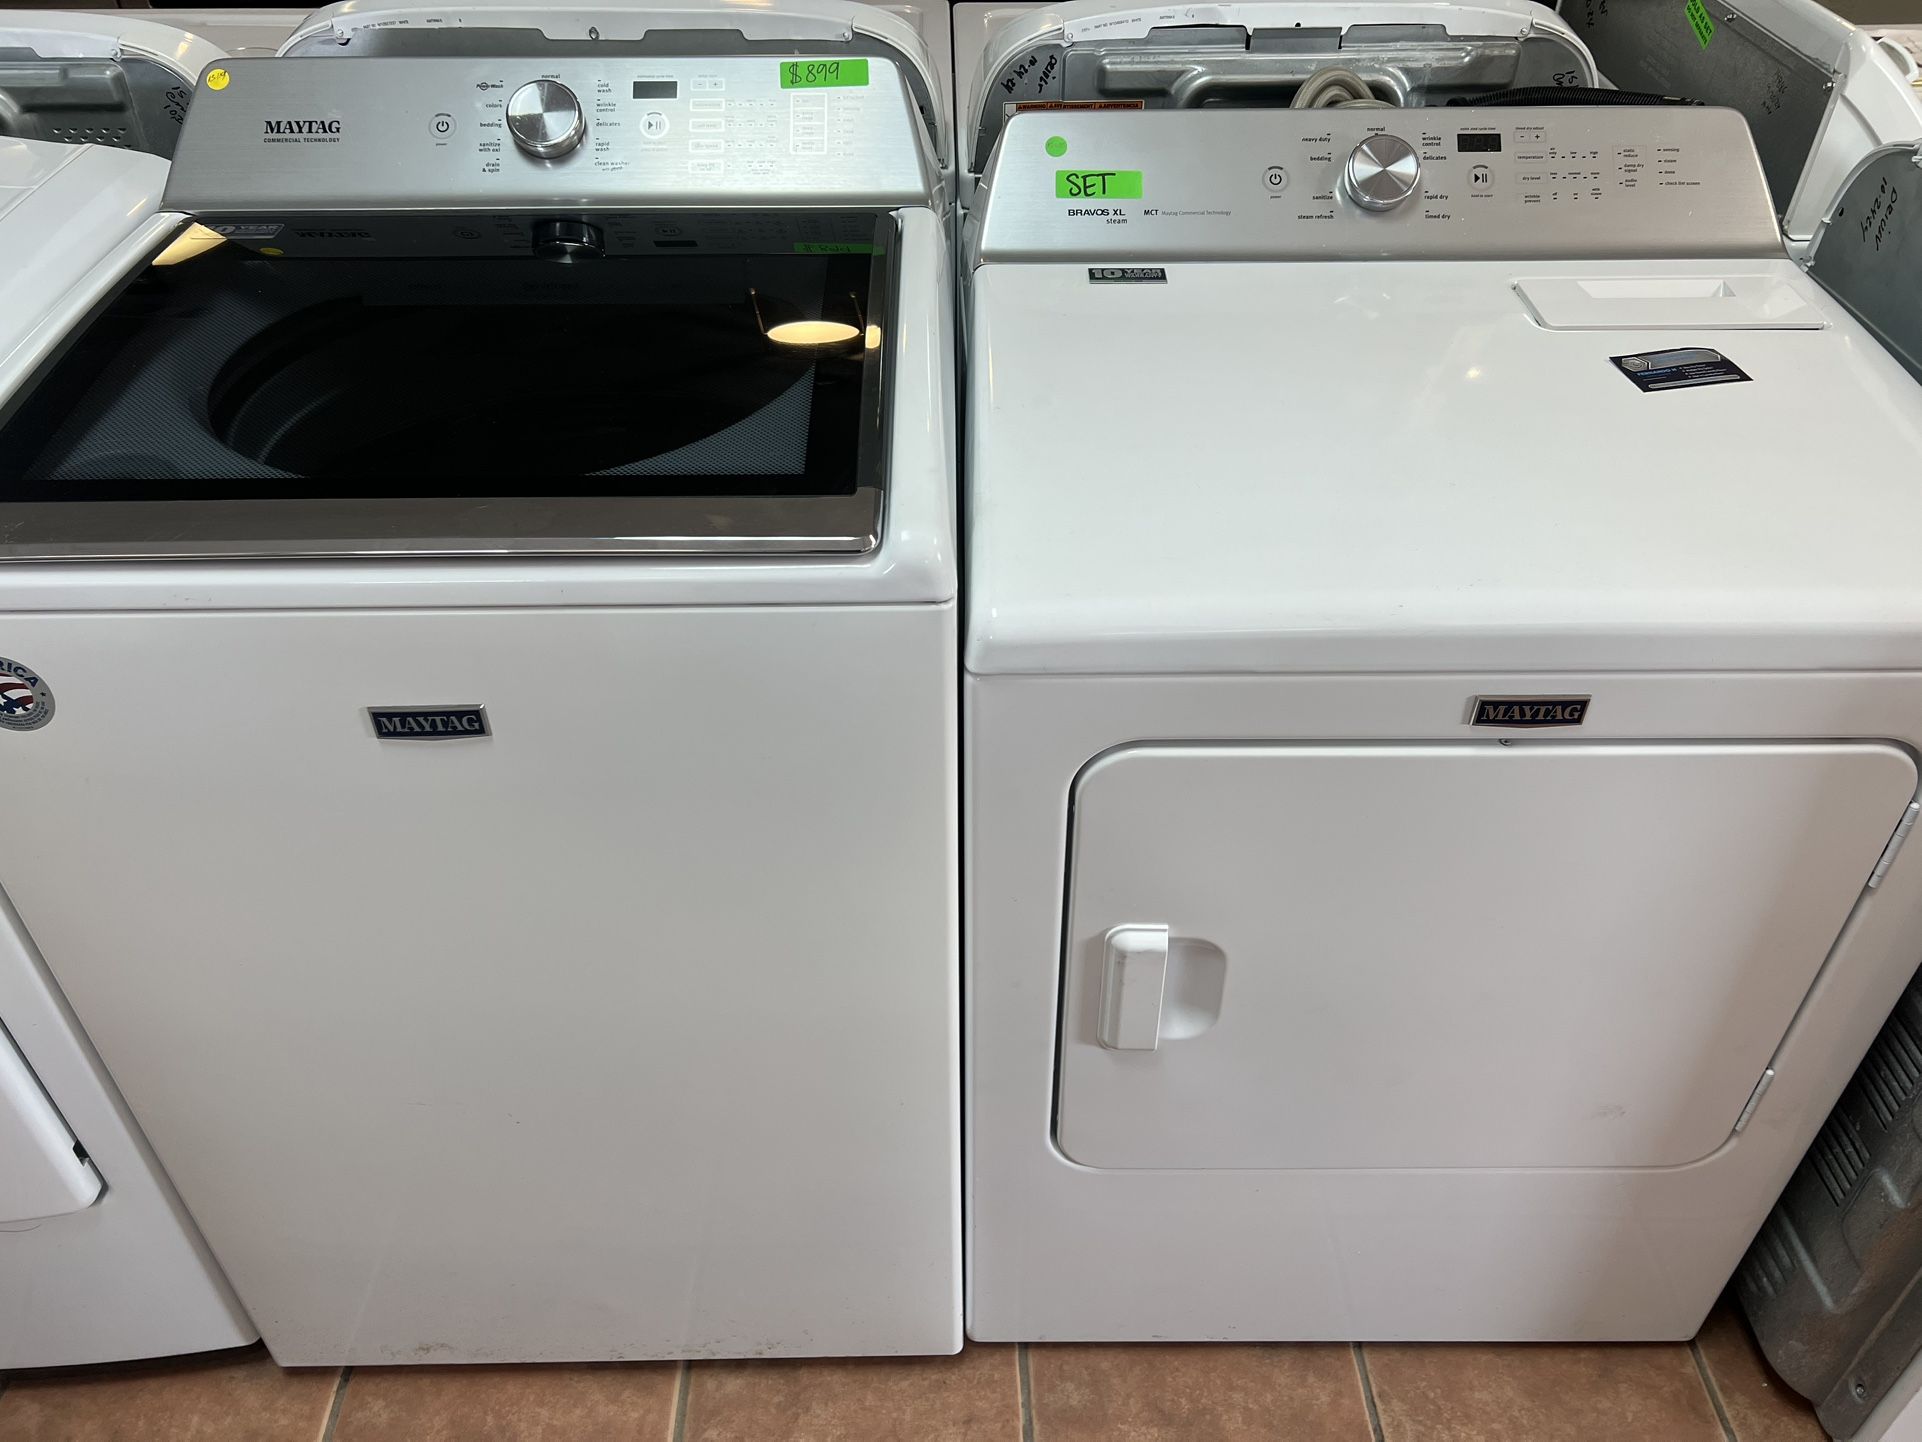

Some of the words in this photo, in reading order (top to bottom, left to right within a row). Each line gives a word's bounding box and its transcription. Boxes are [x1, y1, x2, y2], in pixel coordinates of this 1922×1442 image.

[789, 62, 840, 85] $899
[264, 120, 341, 134] MAYTAG
[1066, 173, 1116, 197] SET
[1206, 209, 1232, 217] Technology
[1092, 269, 1123, 278] 10
[1481, 705, 1581, 720] MAYTAG
[378, 715, 480, 732] MAYTAG
